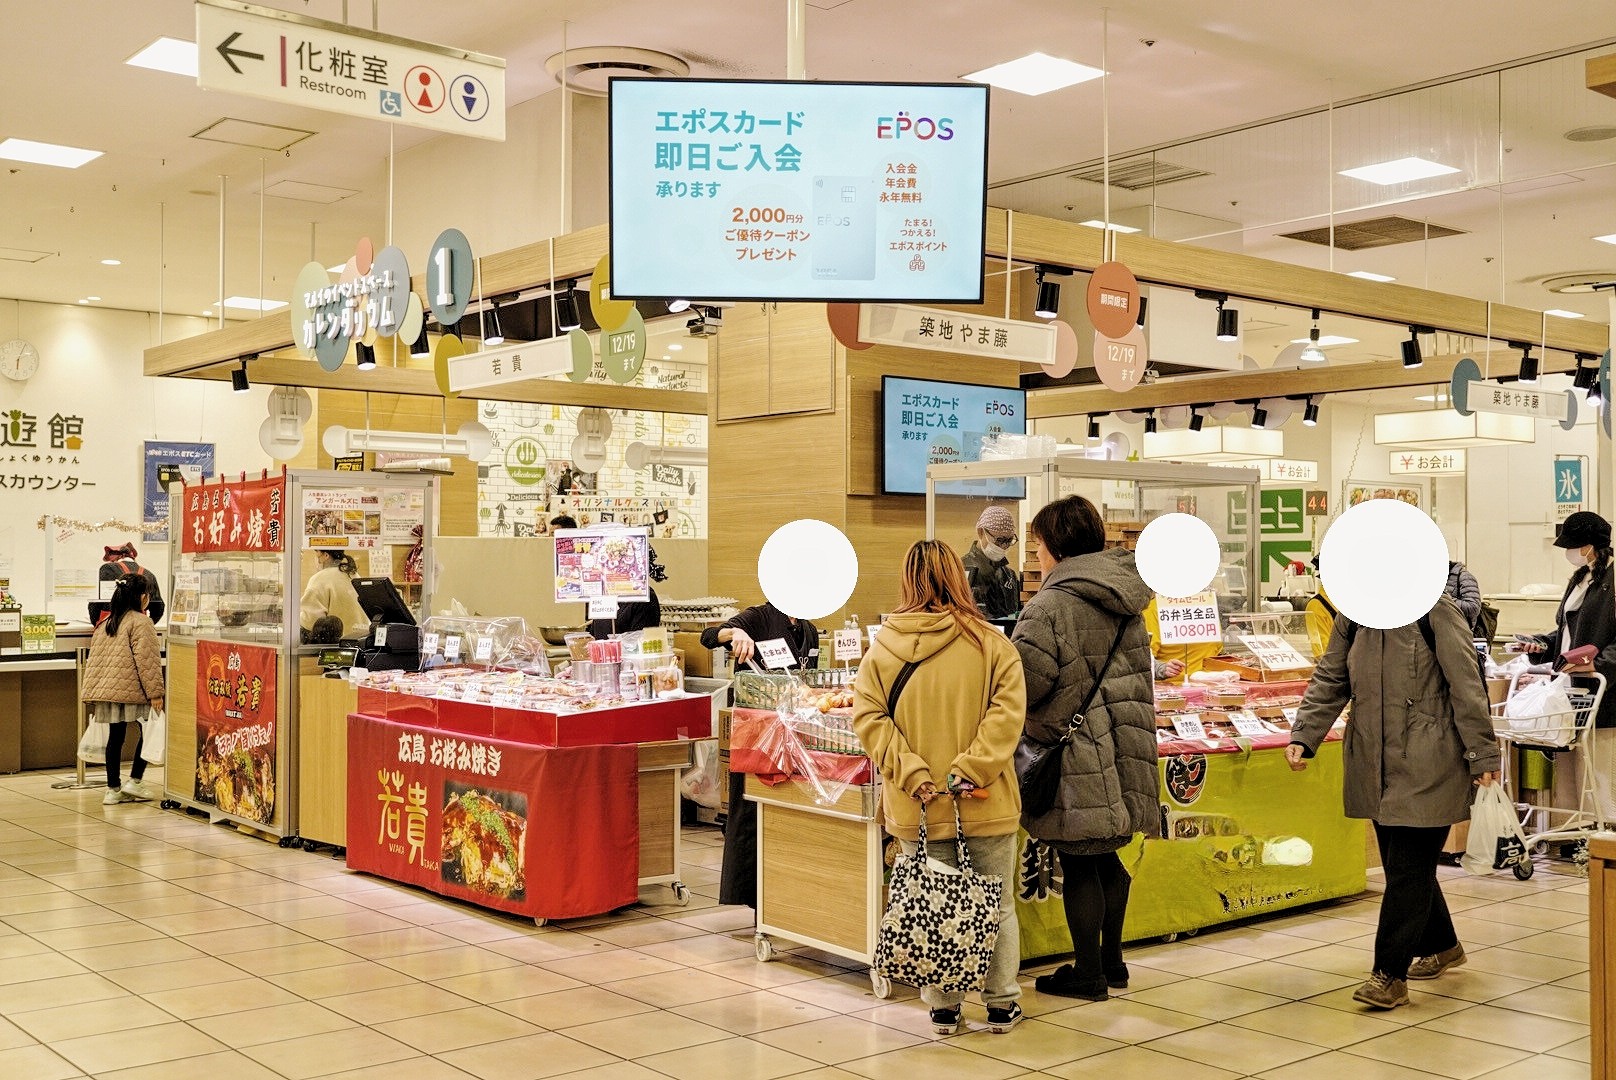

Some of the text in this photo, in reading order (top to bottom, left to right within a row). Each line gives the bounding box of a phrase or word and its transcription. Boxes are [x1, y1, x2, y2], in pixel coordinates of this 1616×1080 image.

[295, 41, 389, 86] 化粧室
[299, 75, 367, 101] Restroom
[655, 107, 805, 136] エポスカード
[877, 111, 954, 141] EPOS
[654, 141, 803, 172] 即日ご入会
[885, 163, 918, 175] 入会金
[655, 180, 722, 198] 承ります
[885, 177, 918, 189] 年会費
[879, 191, 923, 204] 永年無料
[732, 207, 804, 224] 2,000円分
[725, 228, 811, 242] ご優待クーポン
[736, 247, 798, 262] プレゼント
[889, 241, 948, 252] エポスポイント
[435, 247, 454, 307] 1
[1100, 292, 1128, 309] 期間限定
[303, 296, 395, 349] カレンダリウム
[611, 333, 636, 354] 12/19
[1107, 344, 1135, 363] 12/19
[491, 354, 523, 376] 若貴
[622, 355, 636, 371] まで
[657, 370, 686, 384] Natural
[1120, 369, 1135, 382] まで
[901, 393, 960, 411] エポスカード
[985, 400, 1015, 417] EPOS
[901, 410, 959, 429] 即日ご入会
[901, 430, 928, 442] 承ります
[655, 464, 680, 477] Daily
[1417, 455, 1455, 469] お会計
[656, 473, 682, 485] Fresh
[1558, 468, 1580, 500] 氷
[315, 497, 359, 505] アンガールズに
[192, 508, 265, 548] お好み焼
[1159, 607, 1216, 622] お弁当全品
[1173, 623, 1217, 637] 1080円
[763, 646, 787, 657] たまねぎ
[1261, 653, 1299, 664] カキフライ
[397, 732, 502, 777] 広島 お好み焼き
[377, 767, 429, 867] 若貴
[388, 842, 405, 856] WAKA
